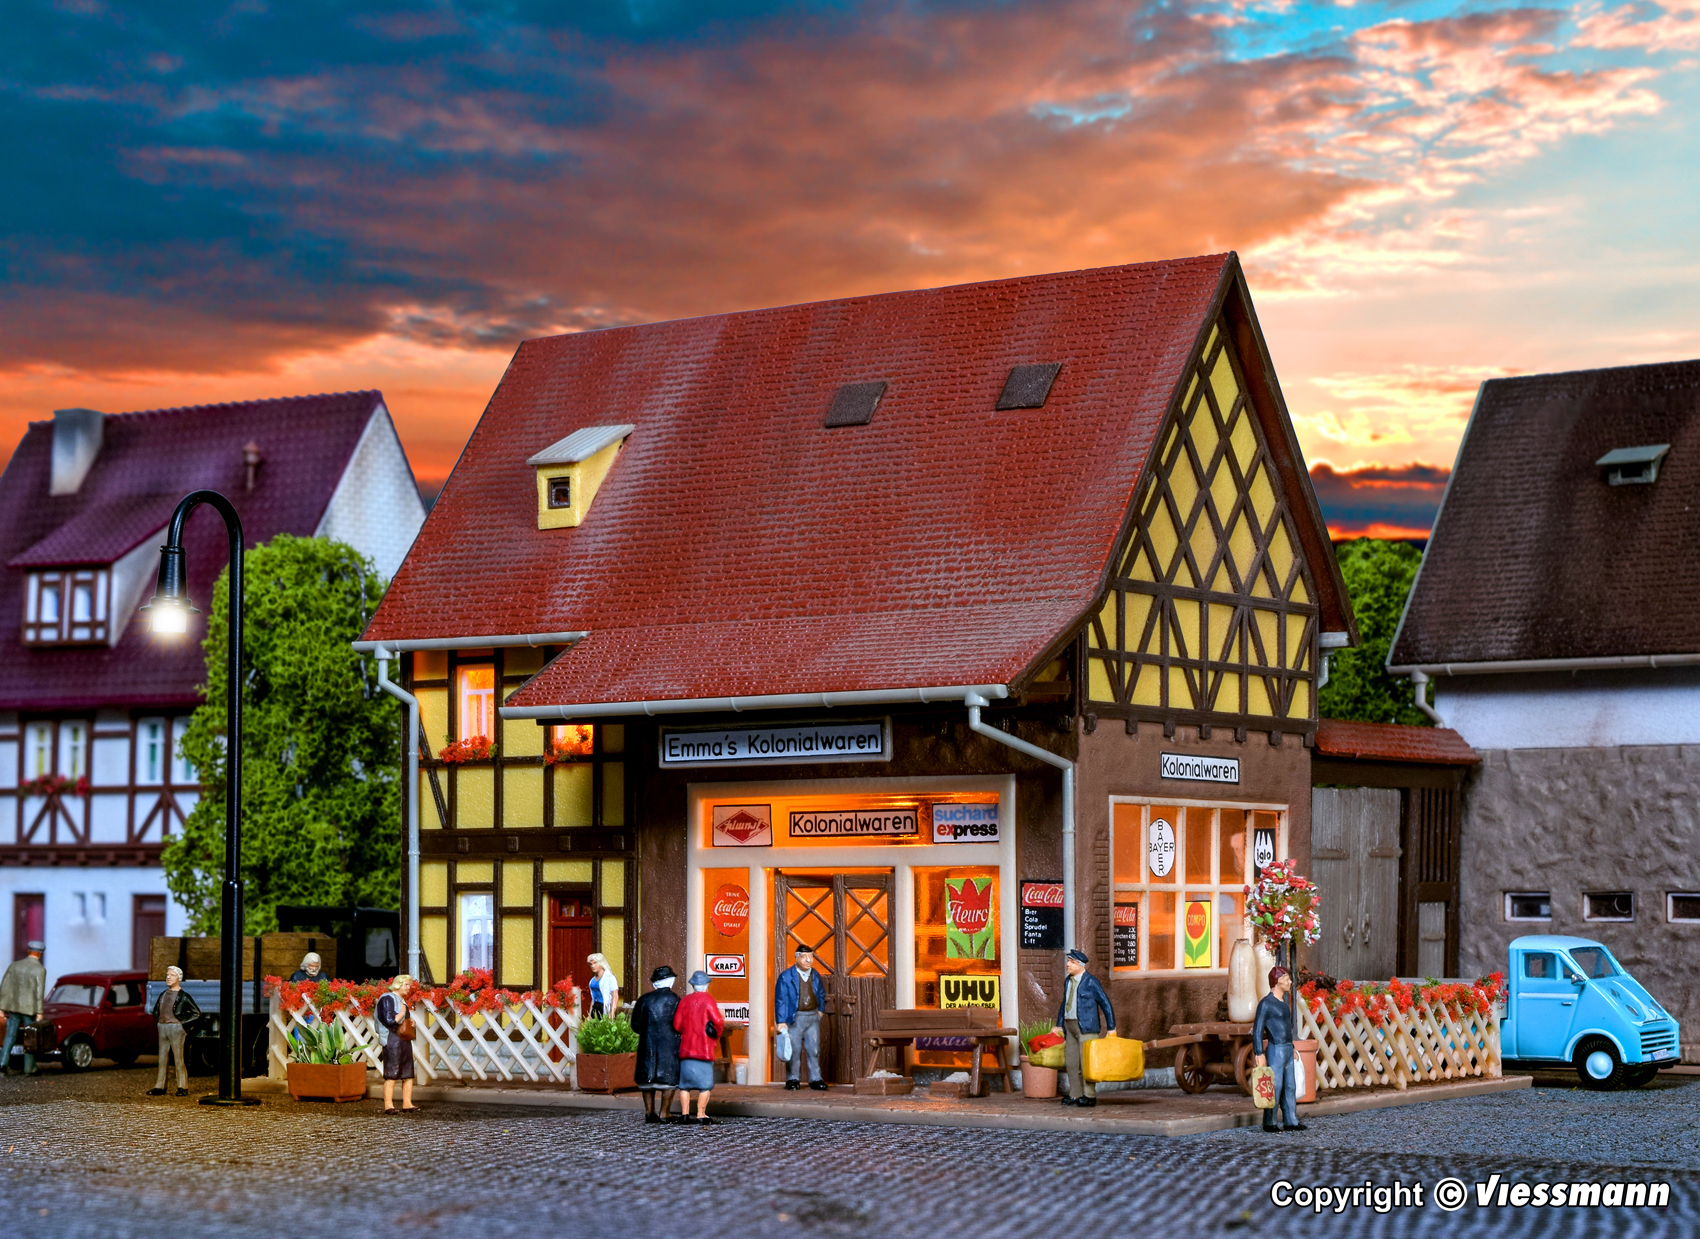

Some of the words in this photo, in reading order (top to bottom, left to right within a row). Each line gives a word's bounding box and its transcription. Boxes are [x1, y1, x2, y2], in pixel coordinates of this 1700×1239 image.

[668, 734, 738, 758] Emma's
[748, 732, 879, 754] Kolonialwaren
[1162, 756, 1237, 780] Kolonialwaren
[935, 804, 998, 821] suchard
[792, 812, 914, 834] Kolonialwaren
[936, 823, 998, 840] express
[1256, 848, 1272, 864] iglo
[1024, 923, 1048, 931] Sprudel
[1024, 930, 1042, 938] Fanta
[944, 979, 995, 1002] UHU
